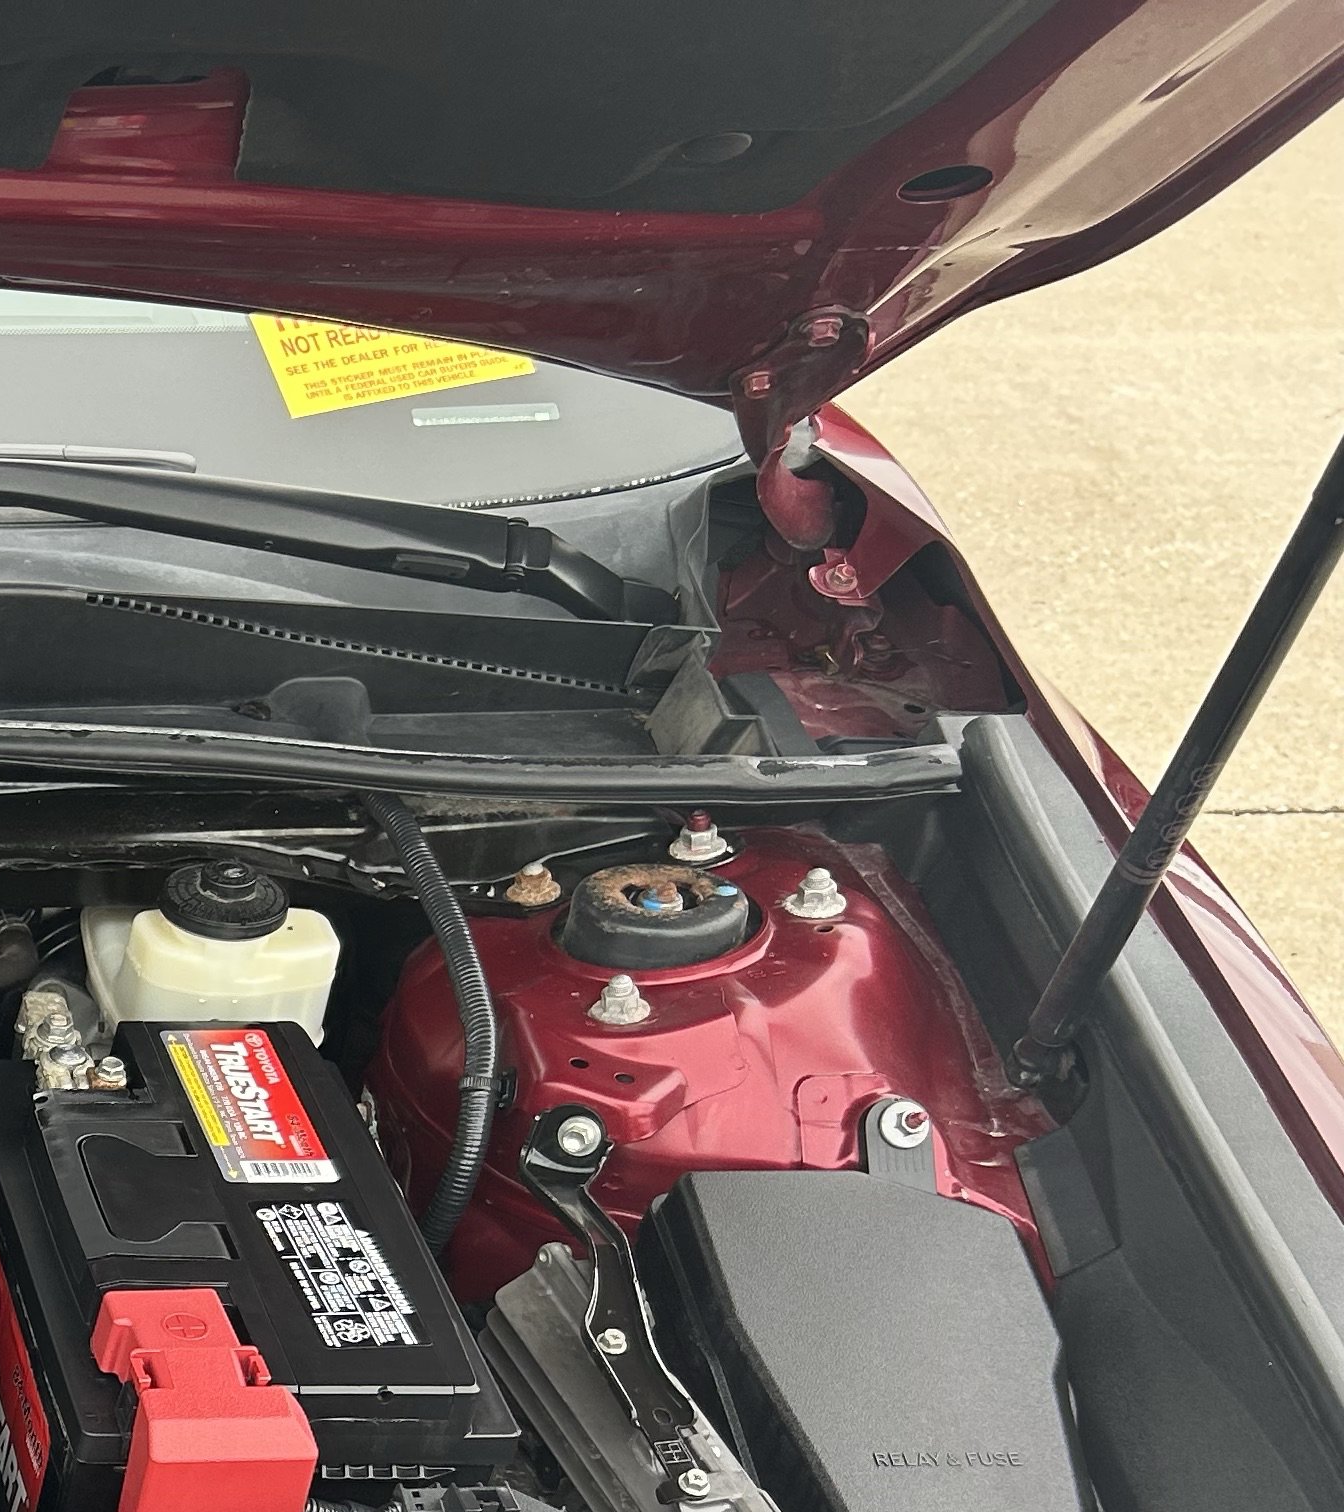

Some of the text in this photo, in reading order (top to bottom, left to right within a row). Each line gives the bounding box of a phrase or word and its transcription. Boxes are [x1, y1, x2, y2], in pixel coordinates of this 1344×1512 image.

[279, 326, 391, 358] NOT READ
[285, 363, 310, 377] SEE
[313, 358, 338, 371] THE
[341, 348, 389, 366] DEALER
[394, 342, 419, 356] FOR
[303, 380, 328, 391] THIS
[330, 370, 374, 386] STICKER
[378, 364, 408, 377] MUST
[412, 355, 454, 370] REMAIN
[456, 353, 468, 362] IN
[305, 389, 333, 400] UNTIL
[335, 386, 343, 394] A
[345, 375, 387, 391] FEDERAL
[389, 372, 415, 383] USED
[418, 368, 437, 379] CAR
[439, 360, 478, 374] BUYERS
[480, 356, 509, 368] GUIDE
[343, 370, 476, 402] IS AFFIXED TO THIS VEHICLE
[252, 1047, 281, 1085] TOYOTA
[872, 1450, 1025, 1468] RELAY & FUSE
